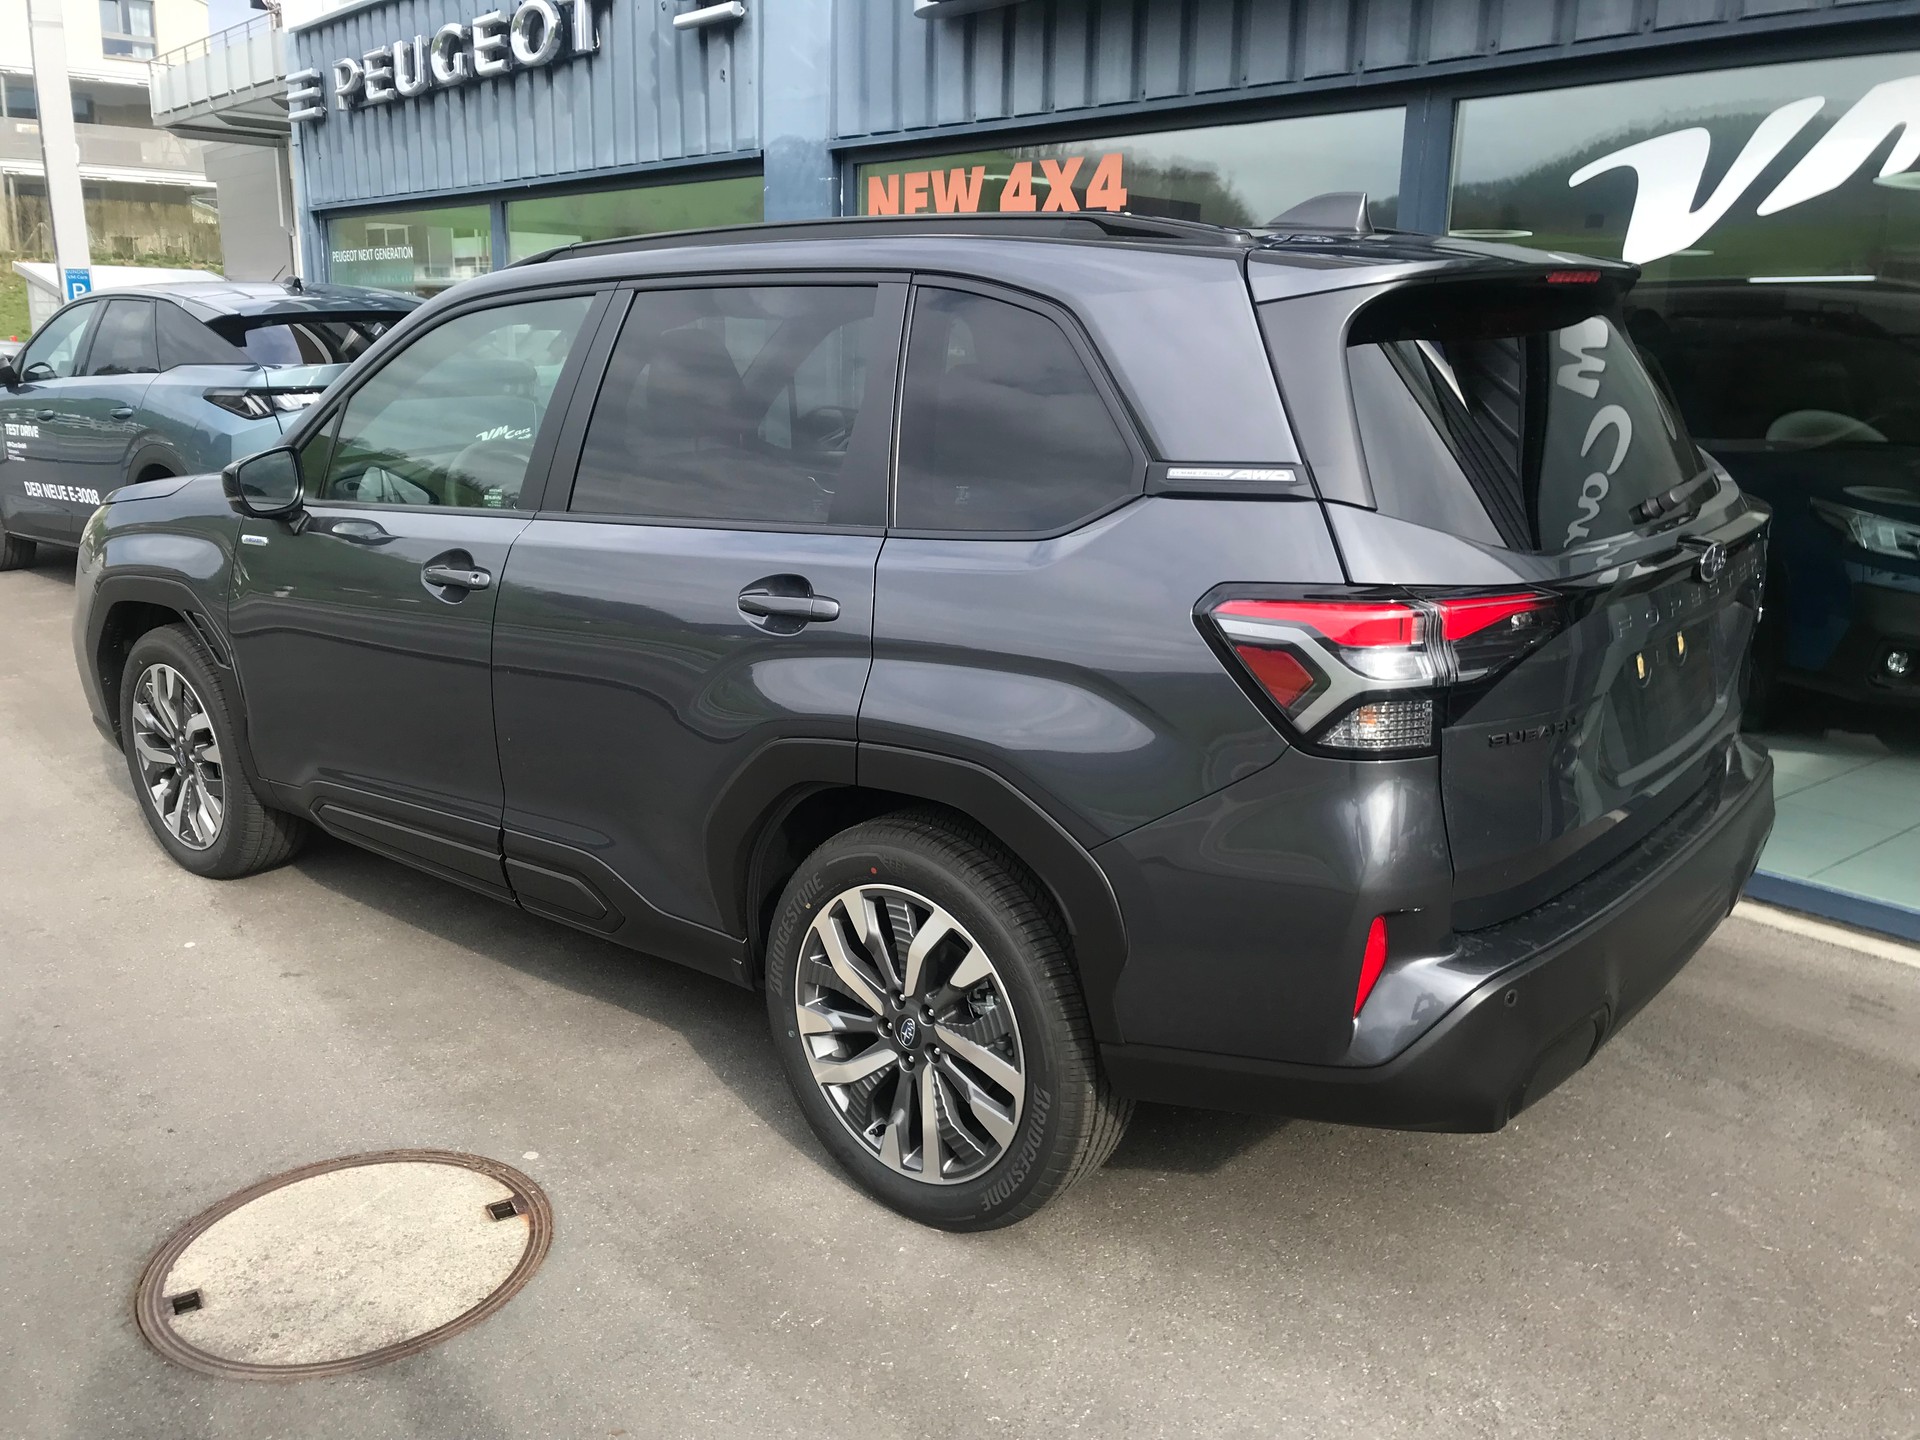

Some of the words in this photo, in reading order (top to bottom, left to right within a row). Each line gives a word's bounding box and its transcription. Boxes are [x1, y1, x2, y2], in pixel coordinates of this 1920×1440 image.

[332, 0, 599, 111] PEUGEOT
[868, 165, 985, 216] NEW
[1000, 152, 1127, 212] 4X4
[332, 250, 357, 263] PEUGEOT
[358, 248, 374, 261] NEXT
[374, 246, 414, 260] GENERATION
[5, 423, 20, 436] TEST
[20, 424, 40, 438] DRIVE
[24, 481, 43, 498] DER
[43, 483, 70, 501] NEUE
[69, 485, 101, 506] E-3008
[1229, 468, 1291, 481] AWD
[770, 871, 825, 999] BRIDGESTONE
[980, 1082, 1052, 1212] BRIDGESTONE
